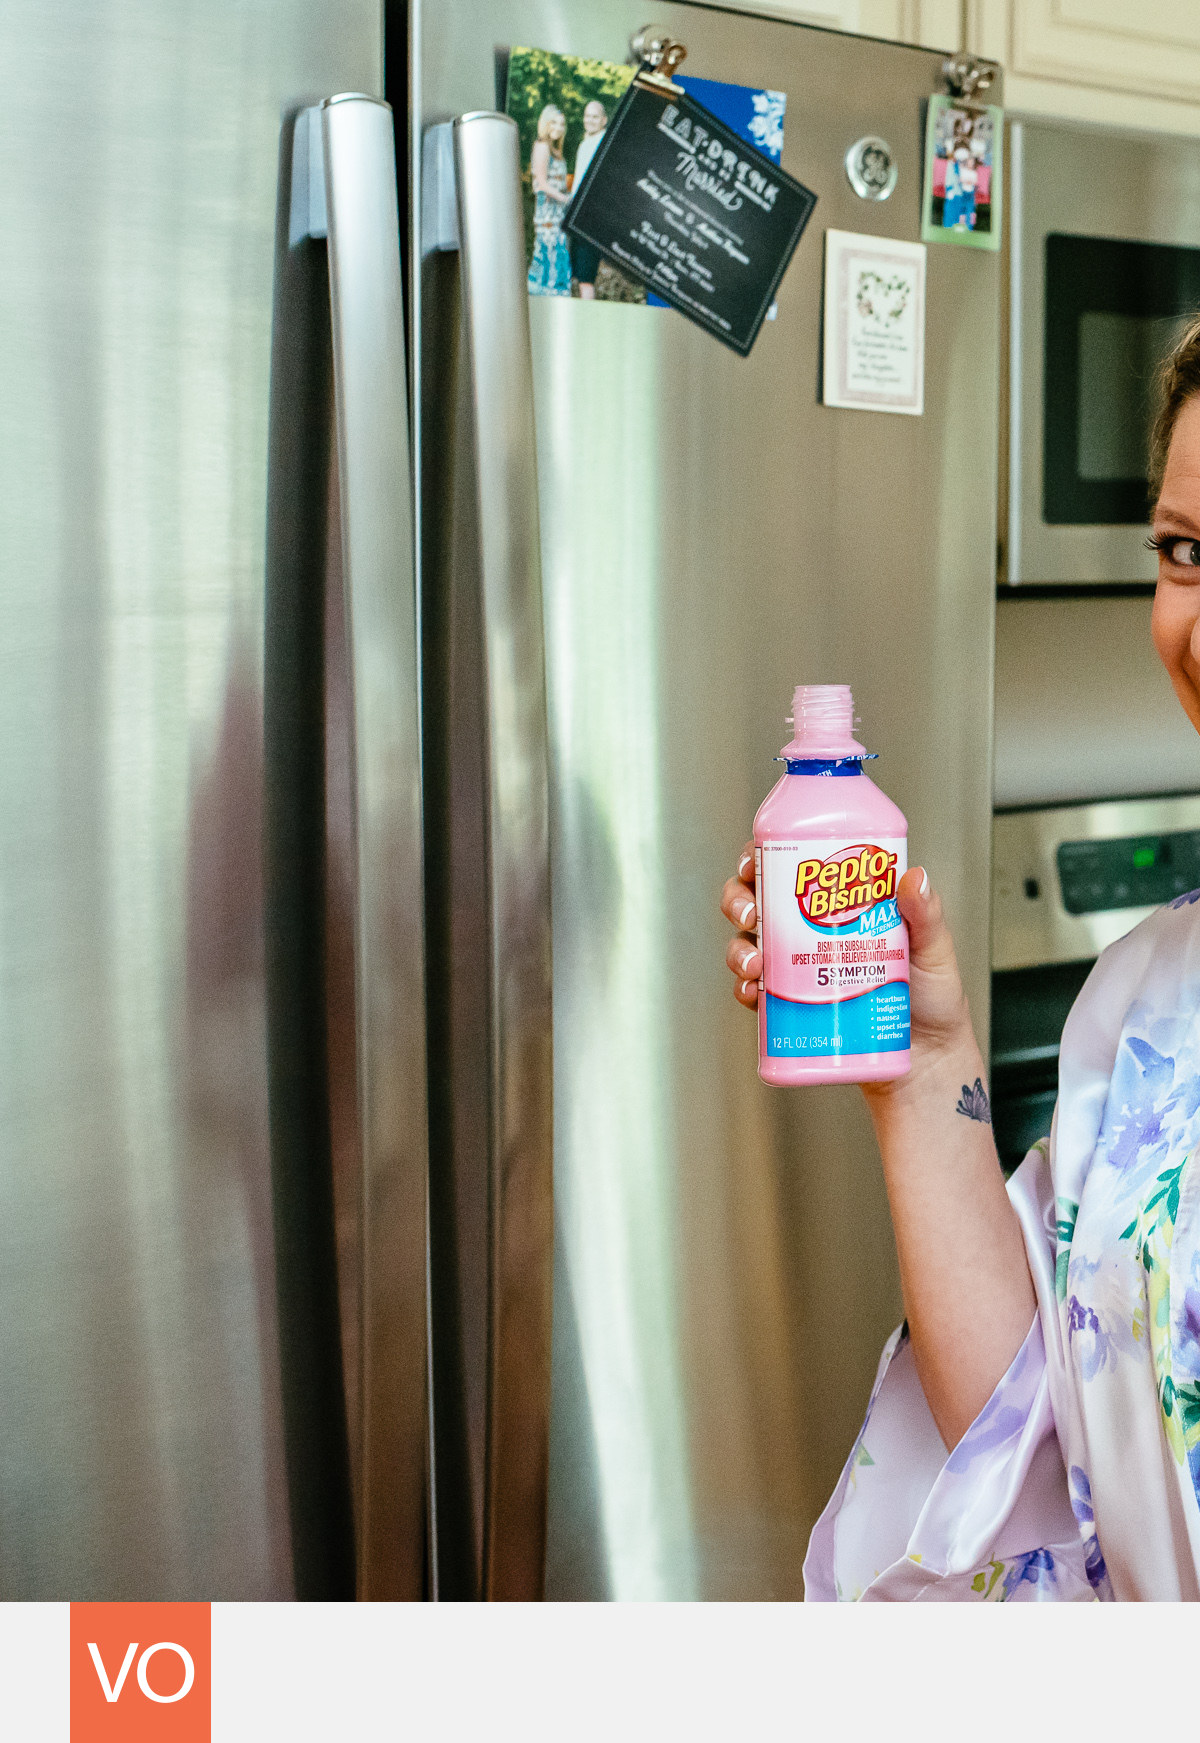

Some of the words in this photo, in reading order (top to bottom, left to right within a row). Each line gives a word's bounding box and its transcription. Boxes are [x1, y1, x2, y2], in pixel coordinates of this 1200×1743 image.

[796, 849, 896, 896] Pepto-
[809, 868, 893, 917] Bismol
[860, 901, 898, 933] MAX
[817, 941, 844, 953] BISMUTH
[844, 939, 887, 952] SUBSALICYLATE
[791, 953, 811, 965] UPSET
[811, 951, 841, 965] STOMACH
[817, 967, 830, 987] 5
[829, 964, 887, 978] SYMPTOM
[829, 976, 865, 987] Digestive
[866, 975, 887, 984] Relief
[876, 1023, 895, 1032] upset
[773, 1037, 782, 1049] 12
[783, 1037, 794, 1049] FL
[795, 1036, 808, 1049] OZ
[809, 1036, 828, 1049] (354
[876, 1032, 904, 1041] diarrhea
